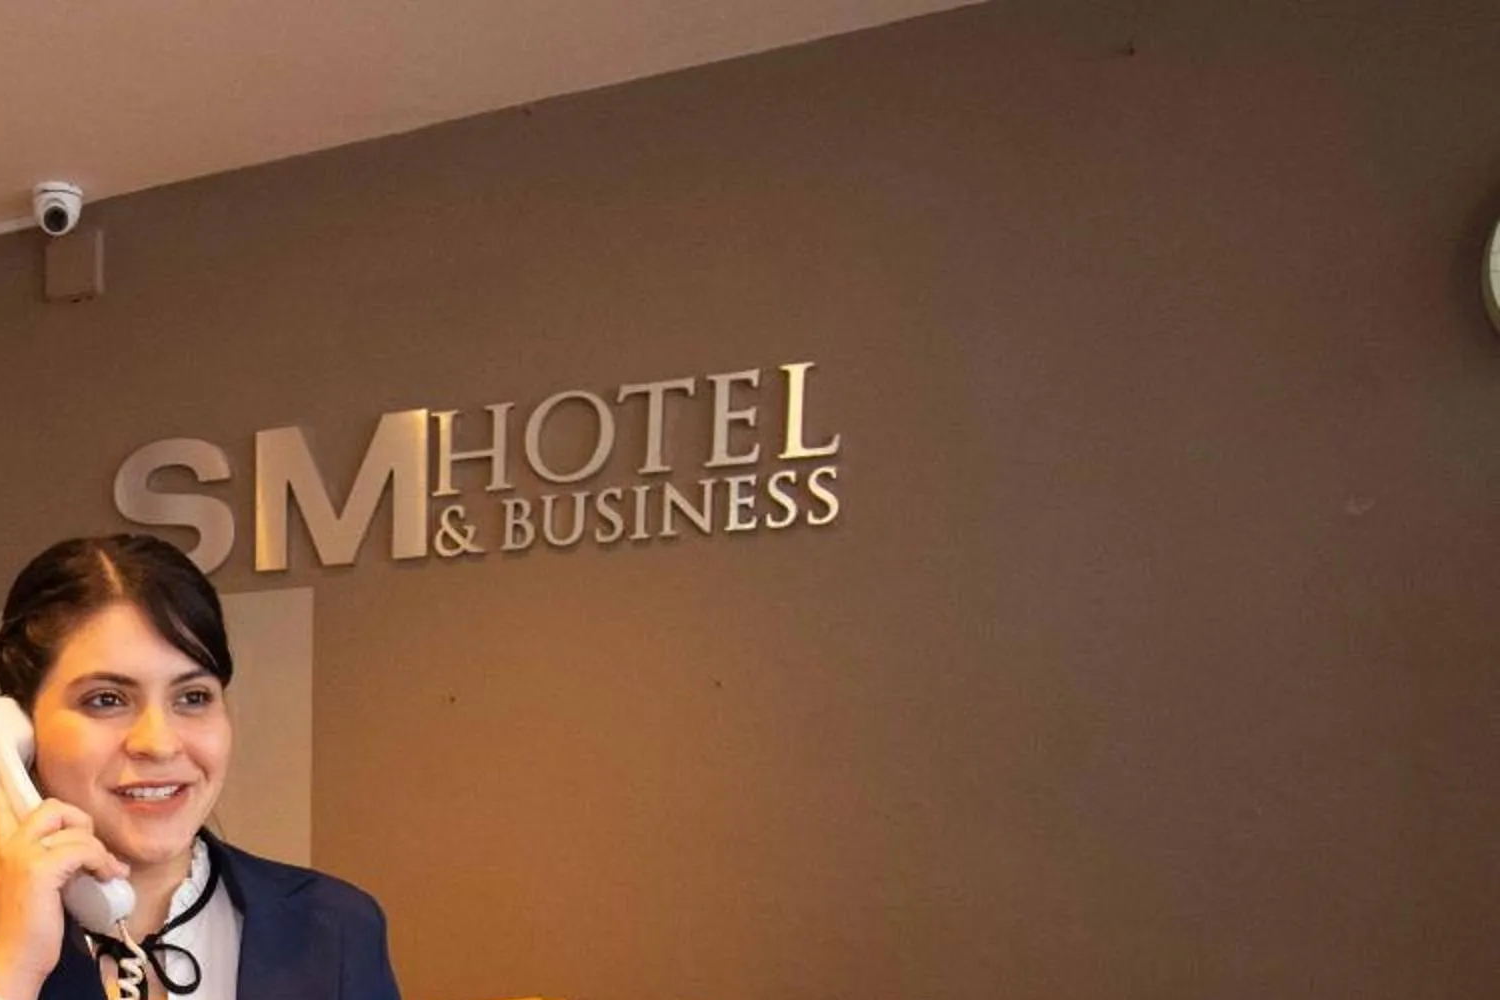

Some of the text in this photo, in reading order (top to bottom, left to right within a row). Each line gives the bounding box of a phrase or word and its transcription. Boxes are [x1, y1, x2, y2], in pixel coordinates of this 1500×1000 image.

[113, 408, 428, 574] SM
[431, 362, 841, 498] HOTEL
[433, 465, 841, 558] & BUSINESS
